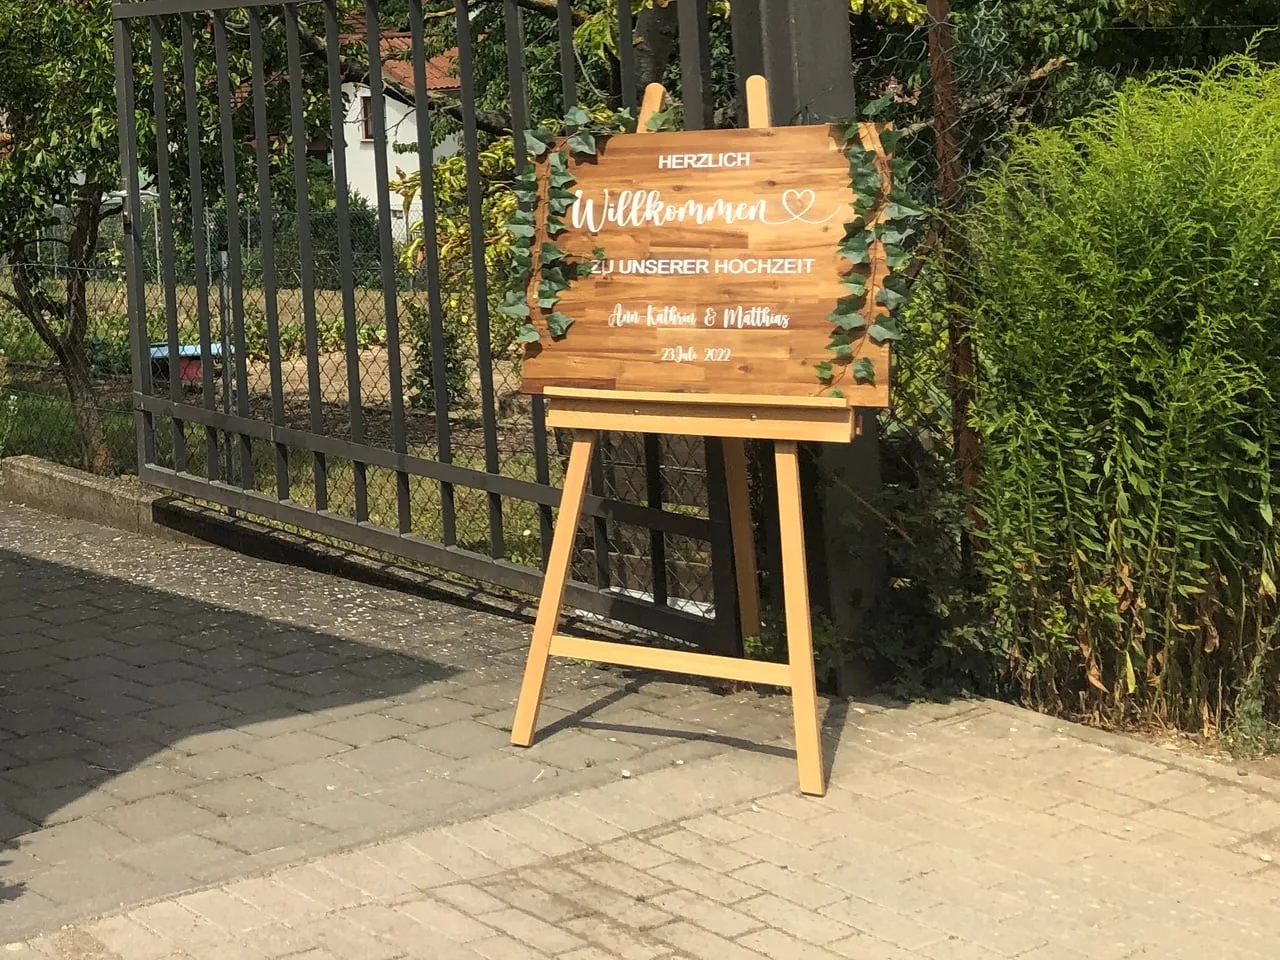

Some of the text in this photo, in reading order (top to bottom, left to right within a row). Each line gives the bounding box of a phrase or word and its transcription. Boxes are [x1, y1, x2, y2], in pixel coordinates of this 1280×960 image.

[658, 151, 751, 170] HERZLICH
[571, 188, 768, 233] Willkommen
[590, 258, 816, 275] ZU UNSERER HOCHZEIT
[608, 303, 791, 329] Ann-Kathrin & Matthias
[704, 348, 731, 362] 2022
